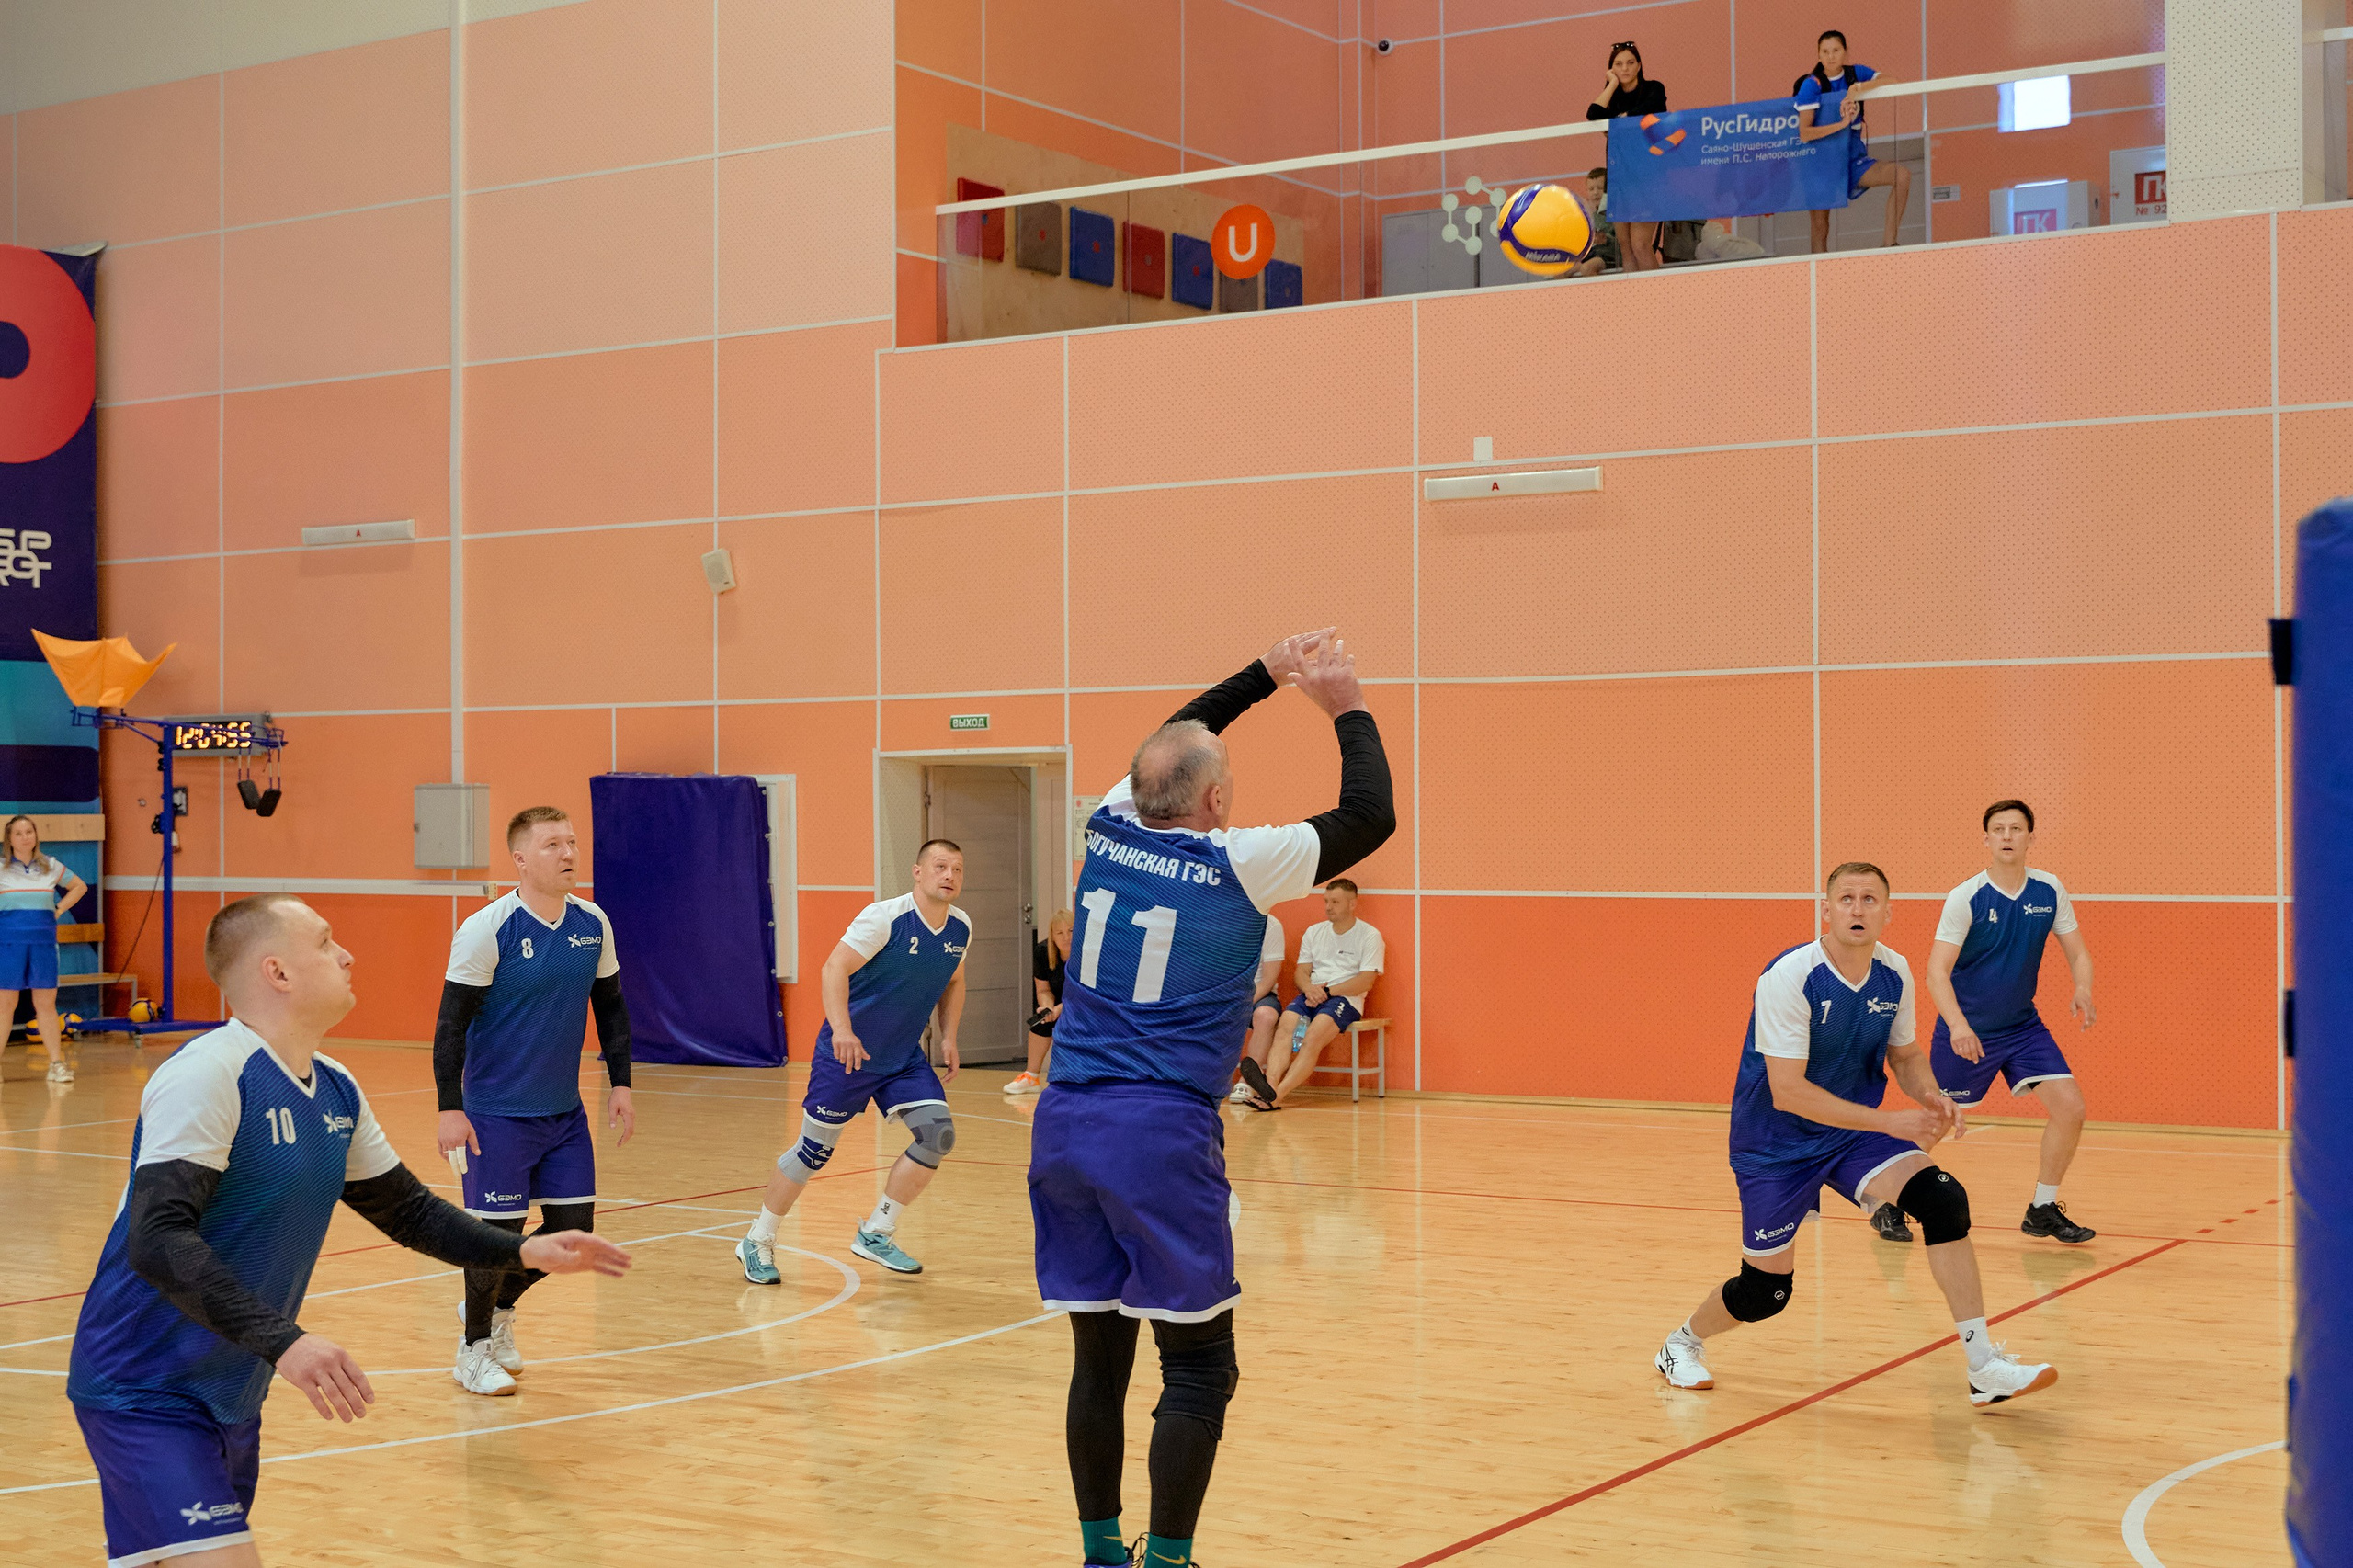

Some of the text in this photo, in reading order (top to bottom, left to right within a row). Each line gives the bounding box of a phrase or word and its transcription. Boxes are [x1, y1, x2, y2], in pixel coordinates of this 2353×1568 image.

[1701, 114, 1800, 139] РусГидро
[1700, 148, 1816, 165] имени П.С. Непорожнего
[1701, 139, 1787, 154] Саяно-Шушенская
[1228, 222, 1257, 263] U
[952, 718, 984, 728] ВЫХОД
[1181, 861, 1222, 886] ГЭС
[1989, 908, 1997, 923] 4
[521, 937, 534, 959] 8
[909, 936, 919, 955] 2
[1080, 887, 1177, 1004] 11
[266, 1107, 296, 1145] 10
